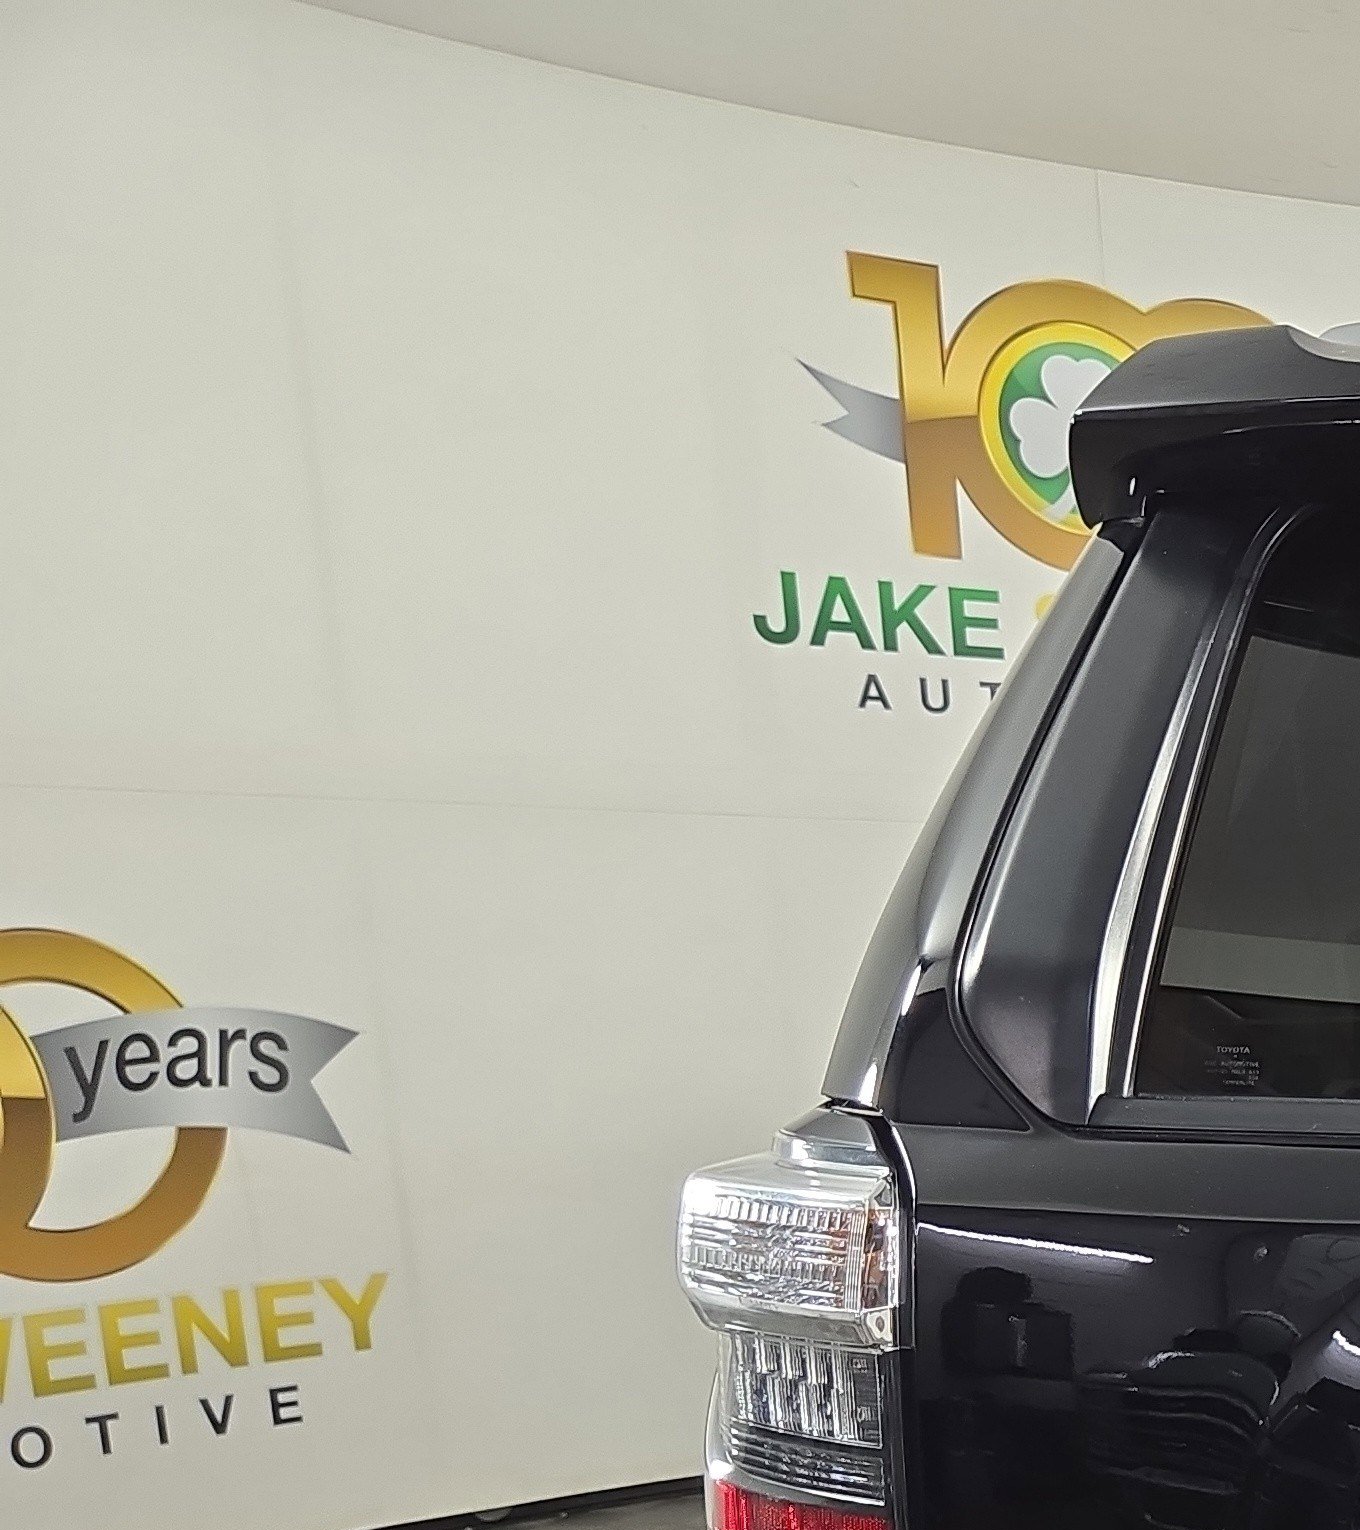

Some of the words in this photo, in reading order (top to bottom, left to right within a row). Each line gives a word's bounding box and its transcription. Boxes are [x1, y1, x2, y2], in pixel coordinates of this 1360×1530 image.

[752, 570, 1006, 661] JAKE
[63, 1026, 290, 1123] years
[1216, 1045, 1250, 1054] TOYOTA
[0, 1272, 389, 1399] EENEY
[10, 1384, 304, 1470] OTIVE
